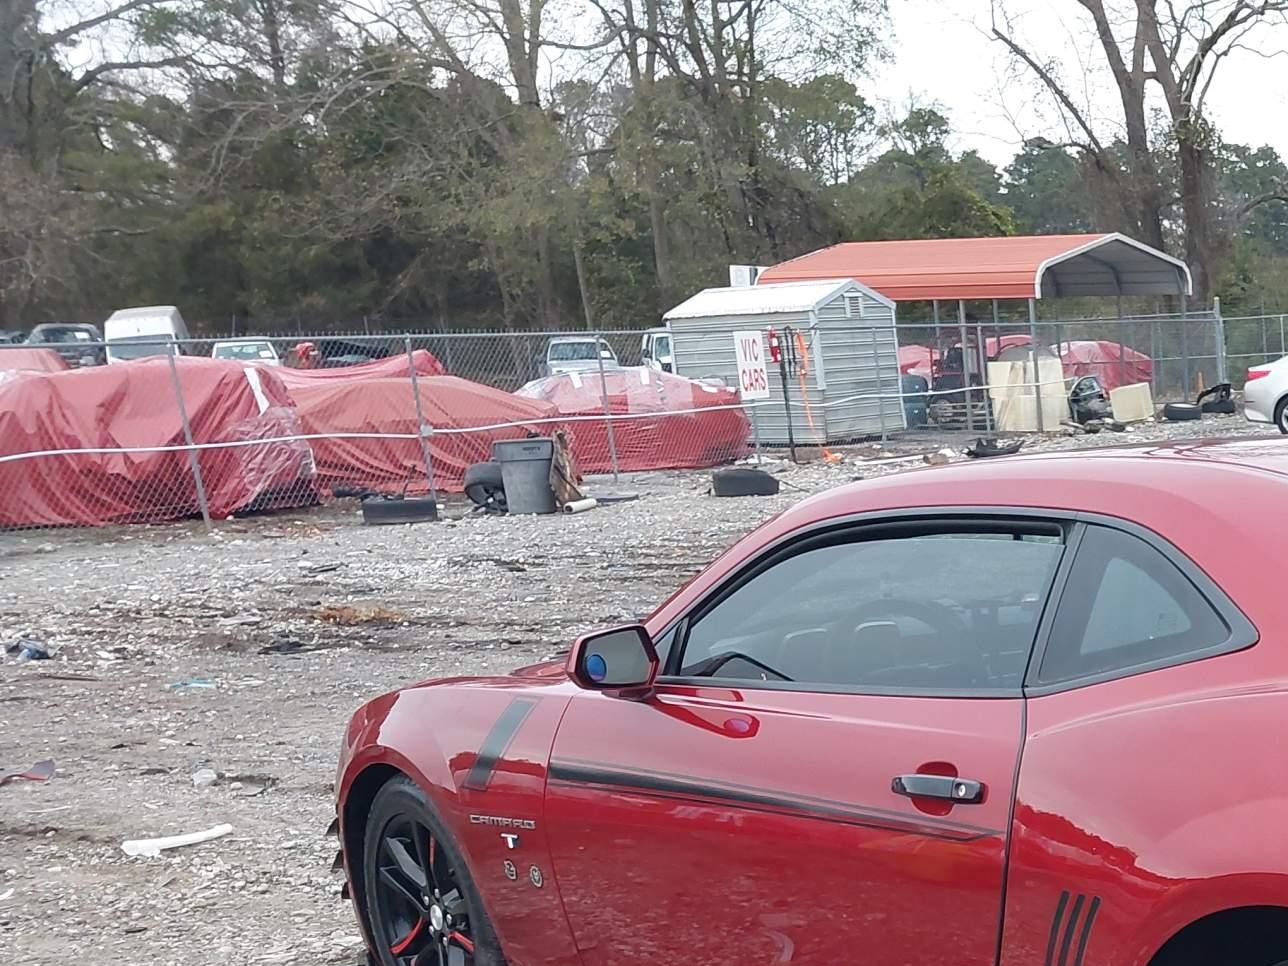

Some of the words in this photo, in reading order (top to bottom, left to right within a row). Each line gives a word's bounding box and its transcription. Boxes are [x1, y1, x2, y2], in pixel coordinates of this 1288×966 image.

[741, 338, 759, 361] VIC
[742, 368, 767, 392] CARS
[469, 814, 536, 829] CAMARO
